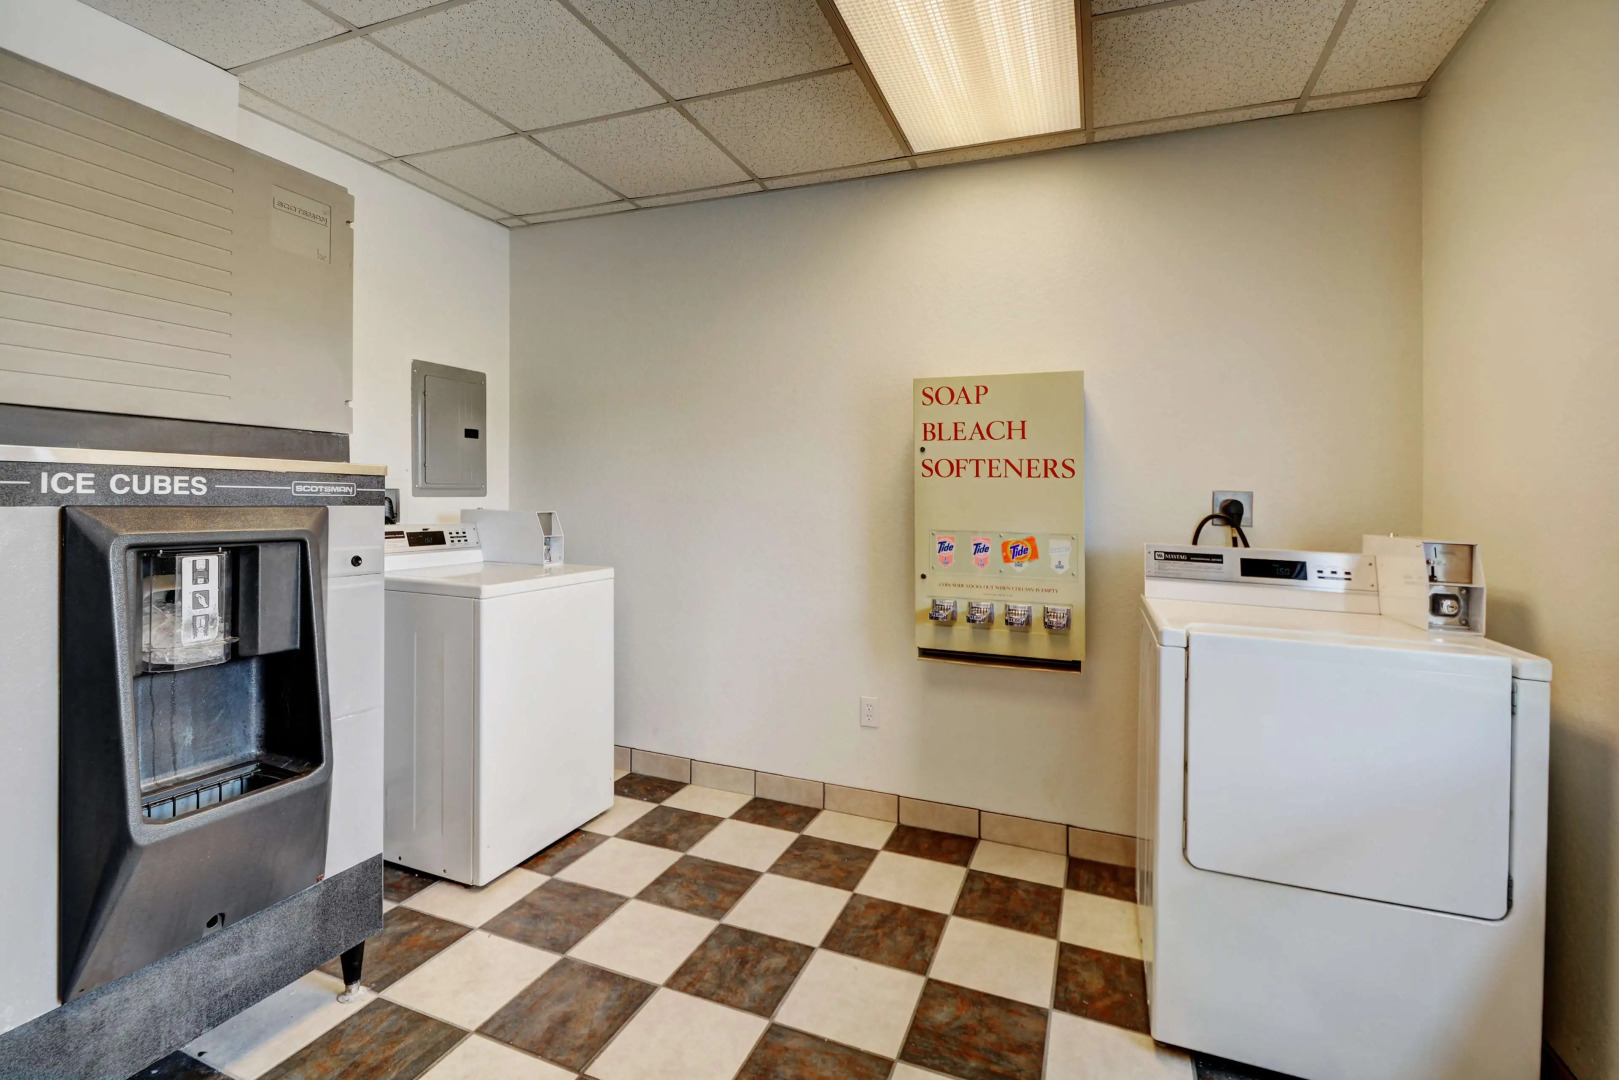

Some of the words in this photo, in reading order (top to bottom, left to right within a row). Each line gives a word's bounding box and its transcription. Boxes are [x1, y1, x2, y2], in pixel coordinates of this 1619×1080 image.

[921, 385, 989, 406] SOAP
[922, 420, 1027, 441] BLEACH
[921, 458, 1076, 479] SOFTENERS
[40, 472, 96, 494] ICE
[109, 473, 208, 496] CUBES
[295, 485, 353, 493] SCOTSMAN
[938, 541, 954, 554] Tide
[973, 542, 989, 555] Tide
[1010, 544, 1029, 559] Tide
